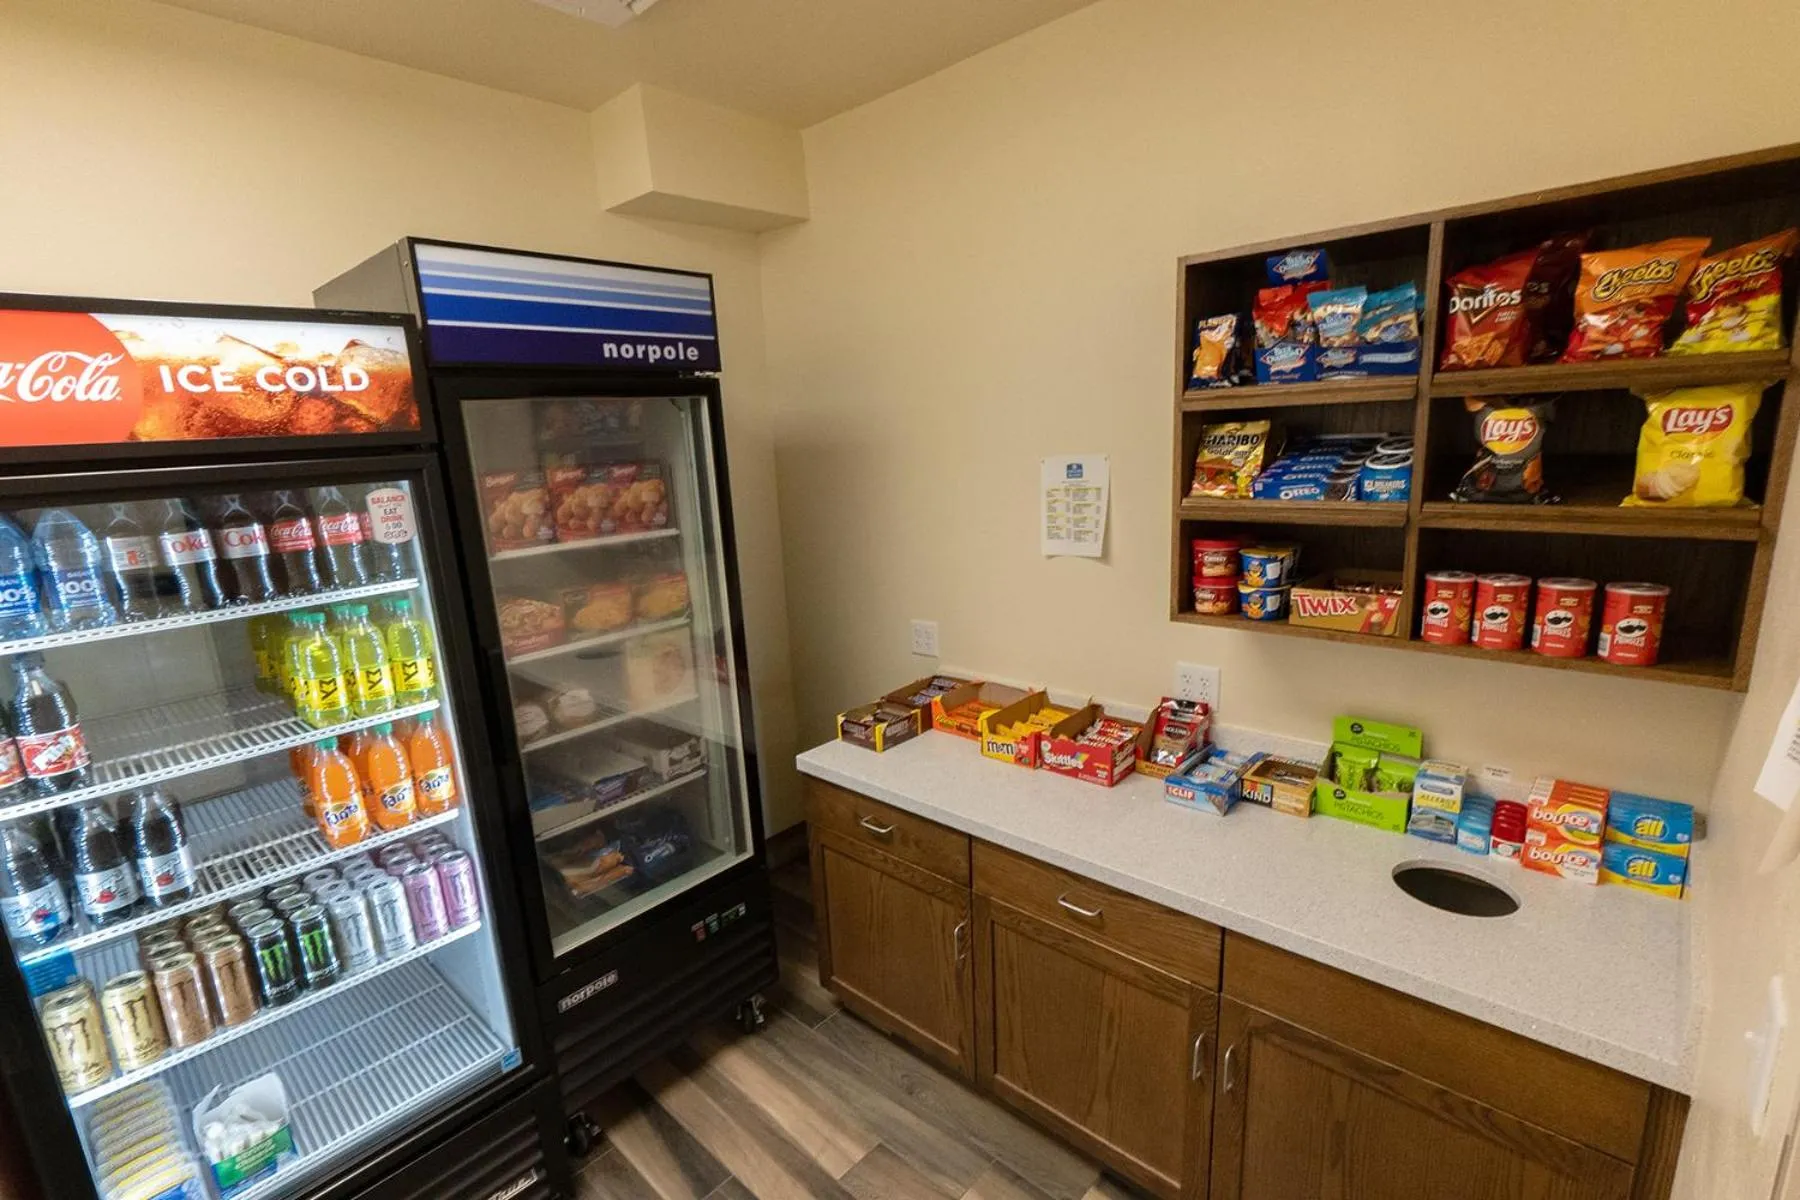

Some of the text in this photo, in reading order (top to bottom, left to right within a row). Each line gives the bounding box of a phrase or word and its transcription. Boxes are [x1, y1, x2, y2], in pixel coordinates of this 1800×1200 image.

[1592, 257, 1679, 300] Cheetos
[1448, 284, 1522, 315] Doritos
[602, 340, 699, 363] norpole
[158, 364, 370, 394] ICE COLD
[1203, 433, 1261, 447] HARIBO
[1241, 787, 1272, 804] KIND
[1533, 804, 1591, 829] bounce
[1635, 820, 1664, 836] all
[1530, 846, 1589, 868] bounce
[1628, 860, 1656, 877] all
